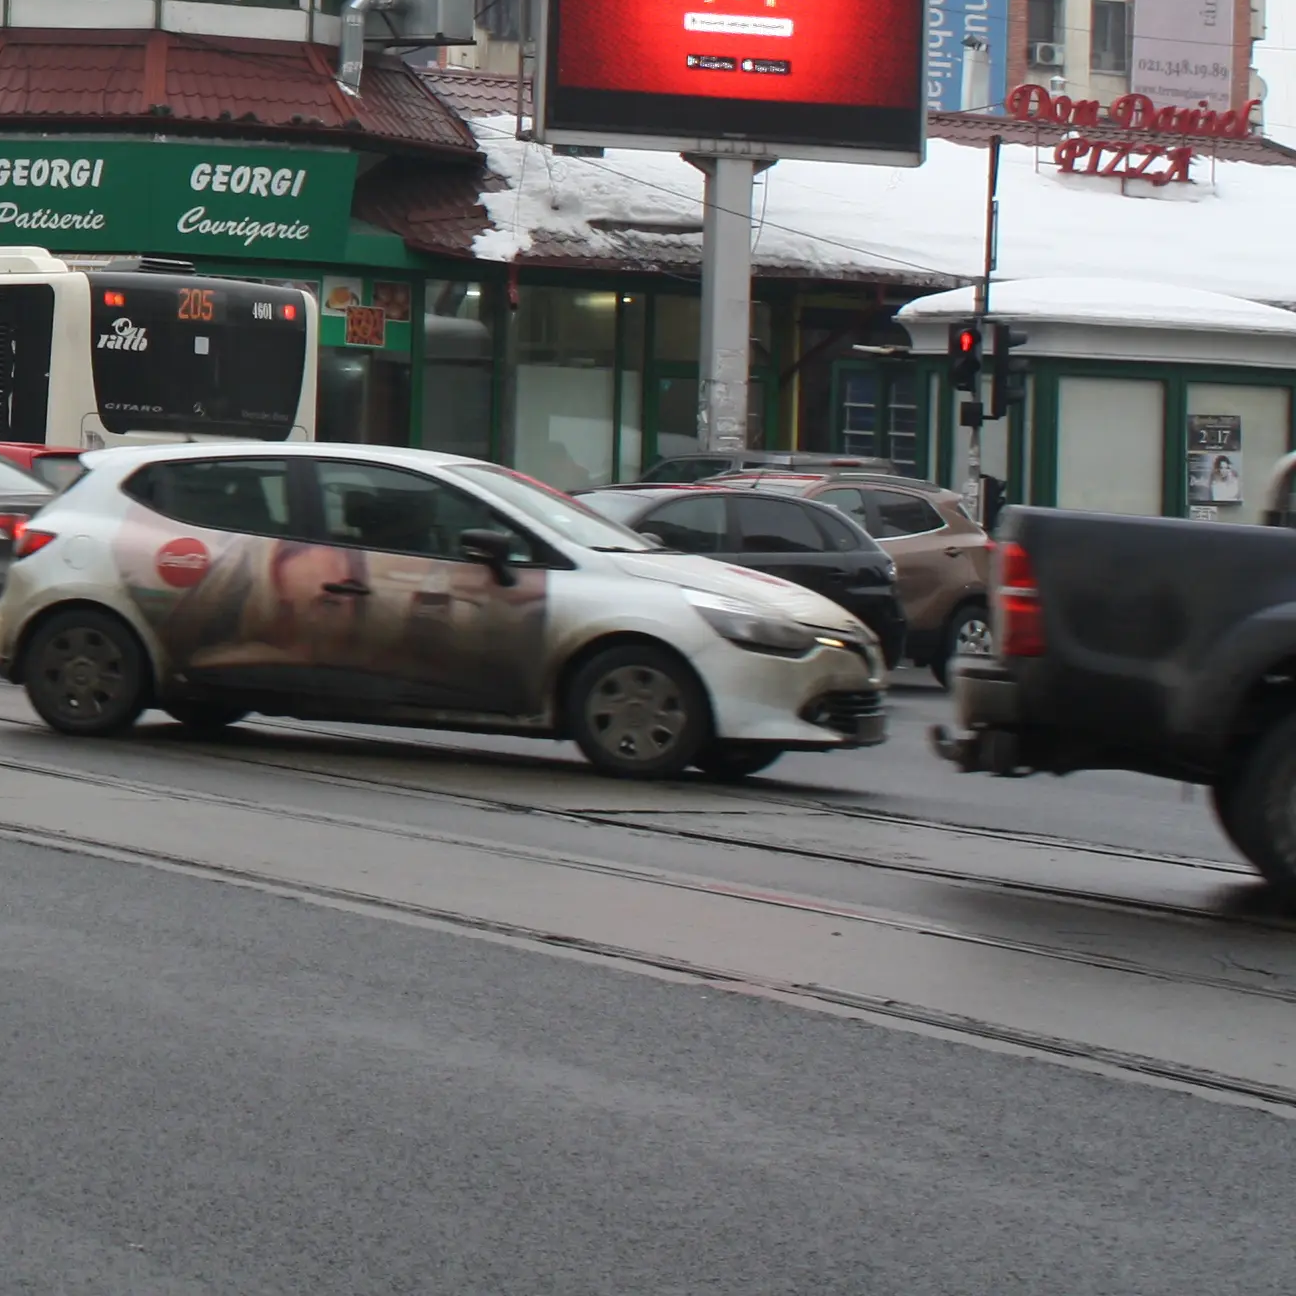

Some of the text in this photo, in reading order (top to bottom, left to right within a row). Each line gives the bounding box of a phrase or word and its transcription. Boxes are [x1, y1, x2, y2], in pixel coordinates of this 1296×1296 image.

[1005, 83, 1262, 139] Don Daniel
[1054, 137, 1198, 187] PIZZA
[190, 162, 308, 198] GEORGI
[177, 287, 214, 320] 205
[252, 302, 273, 320] 4601
[104, 402, 164, 413] CITARO
